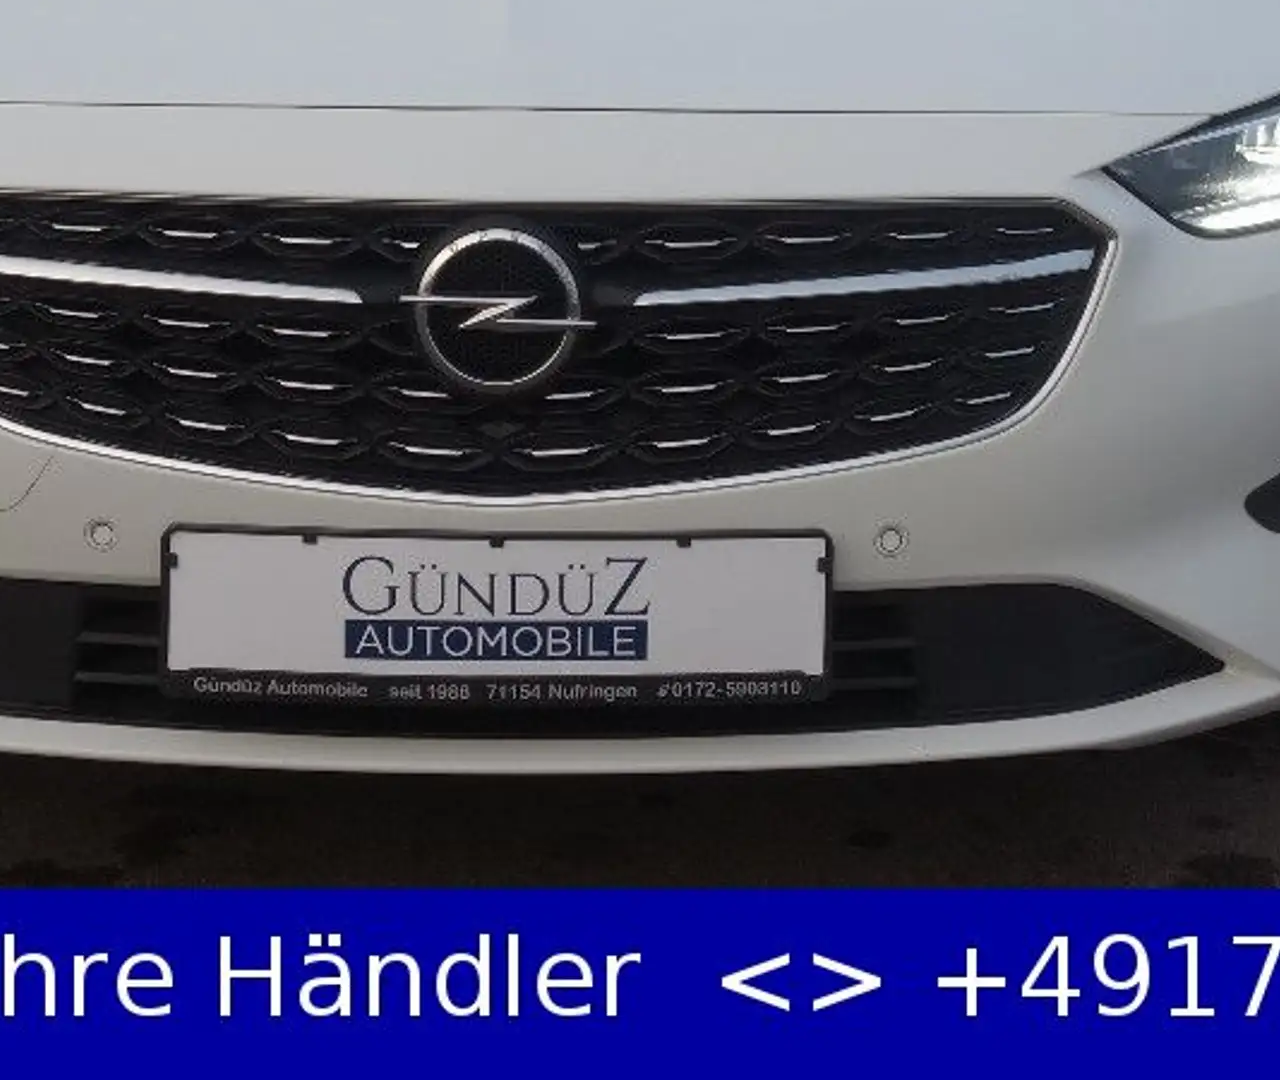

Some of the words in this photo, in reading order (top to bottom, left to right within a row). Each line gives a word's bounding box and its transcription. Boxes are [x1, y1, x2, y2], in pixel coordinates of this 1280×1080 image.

[355, 625, 637, 657] AUTOMOBILE
[193, 676, 262, 695] Gündüz
[267, 678, 369, 698] Automobile
[486, 683, 541, 700] 71154
[547, 682, 638, 703] Nufringen
